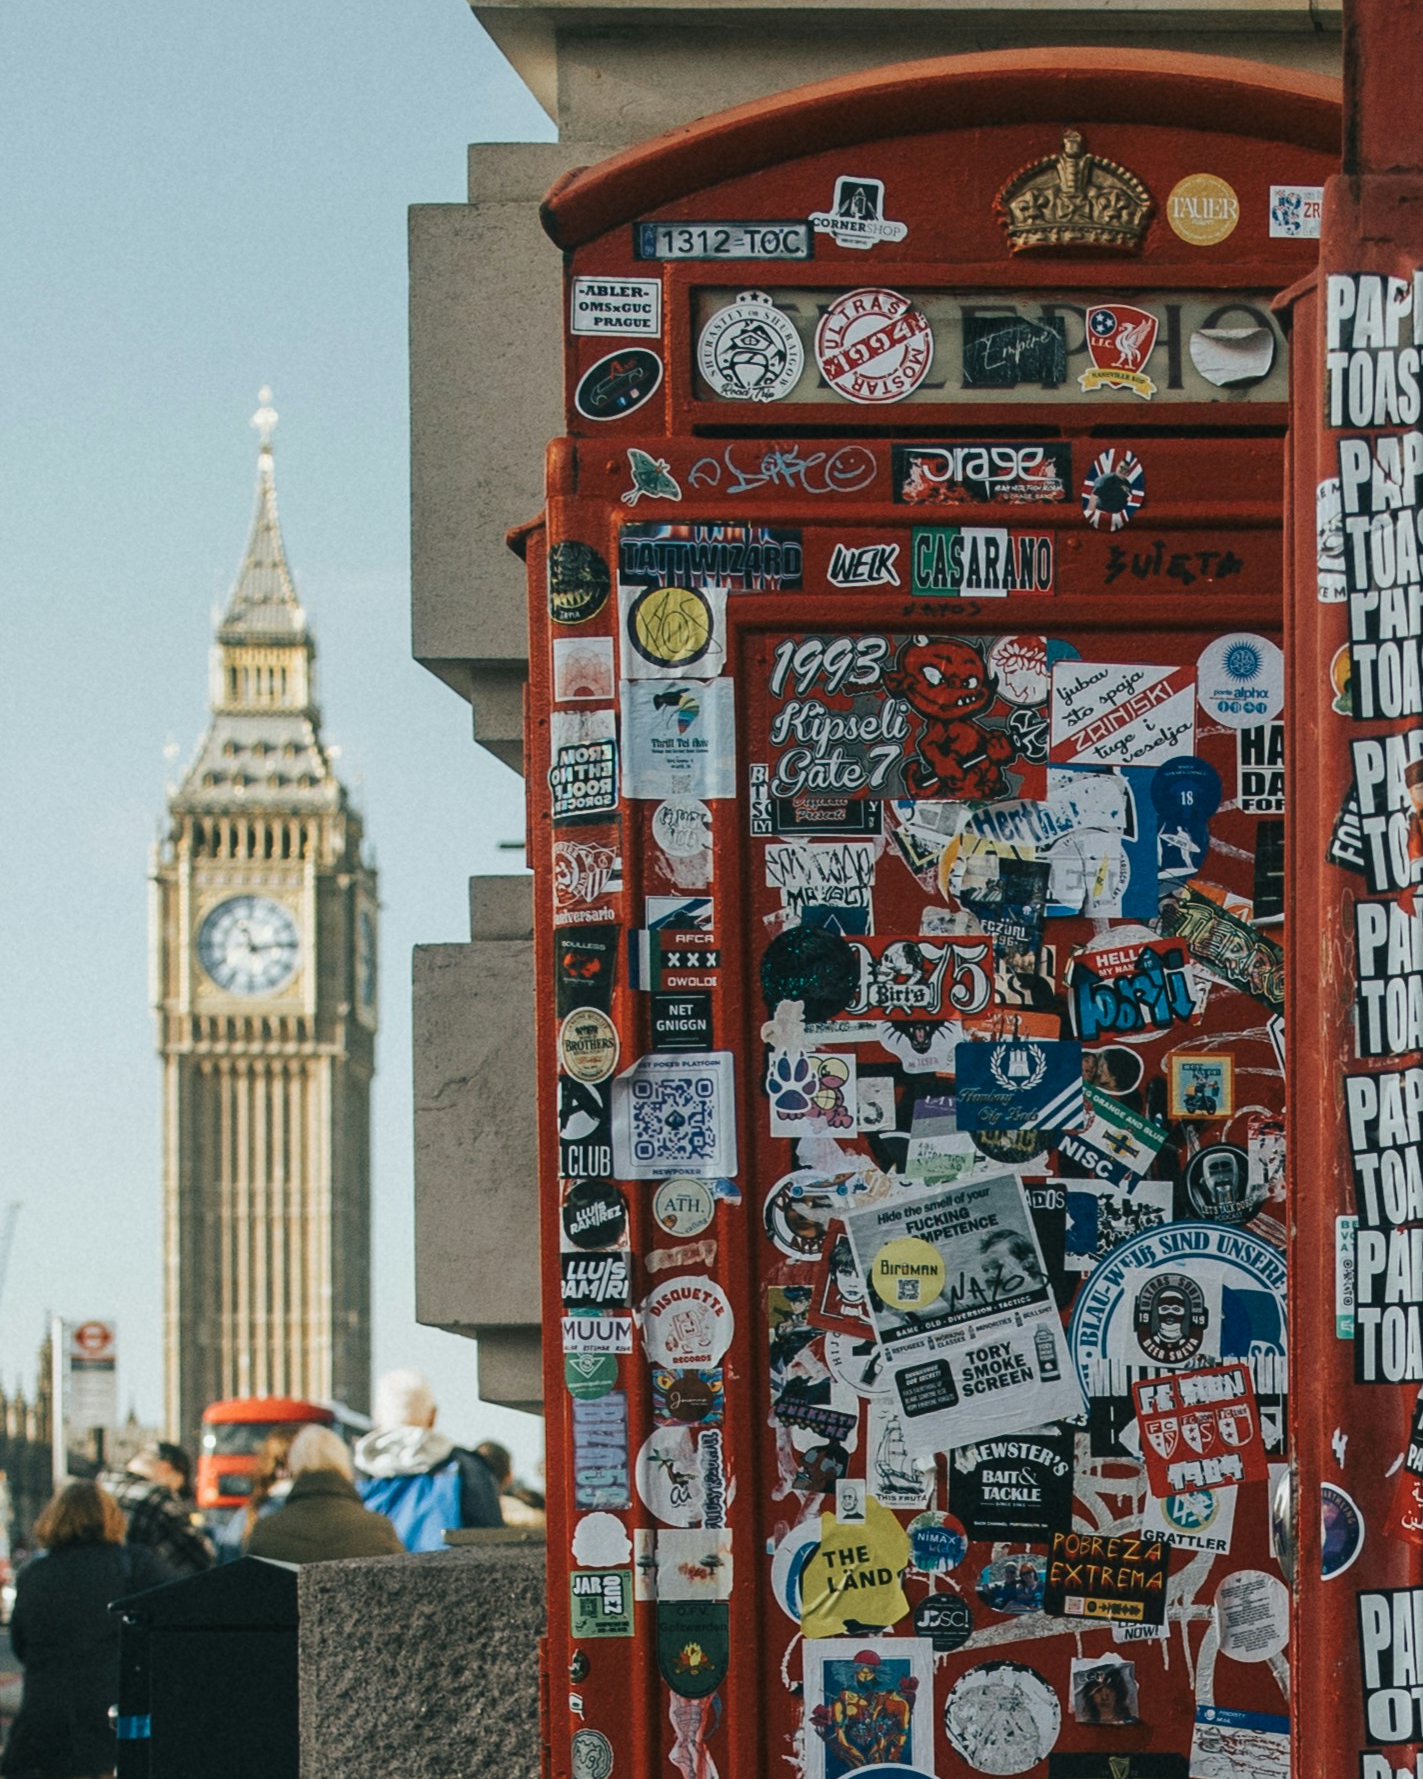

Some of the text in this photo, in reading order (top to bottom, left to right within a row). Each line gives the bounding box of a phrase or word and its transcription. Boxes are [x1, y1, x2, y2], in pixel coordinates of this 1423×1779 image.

[579, 301, 652, 314] OMSxGUC
[593, 316, 651, 328] PRAGUE
[825, 298, 900, 350] ULTRAS
[831, 545, 899, 582] WELK
[914, 534, 1053, 591] CASARANO
[772, 638, 889, 696] 1993
[1057, 669, 1108, 706] ljubav
[1062, 670, 1144, 727] što spaja
[771, 700, 910, 755] Kipseli
[1093, 718, 1156, 759] tuge i
[1122, 721, 1193, 763] veselja
[771, 745, 902, 797] Gate 7
[1181, 791, 1194, 806] 18
[676, 935, 714, 943] AFCA
[669, 1005, 693, 1015] NET
[656, 1020, 706, 1031] GNIGGN
[566, 1040, 615, 1051] BROTHERS
[1058, 1136, 1113, 1178] NISC
[877, 1187, 990, 1226] Hide the smell of your
[906, 1207, 970, 1234] FUCKING
[650, 1287, 725, 1317] DISQUETTE
[1140, 1276, 1203, 1310] ULTRAS SOUTH
[896, 1296, 1031, 1338] SAME OLD DIVERSION TACTICS
[892, 1341, 925, 1355] REFUGEES
[935, 1330, 965, 1342] WORKING
[937, 1337, 966, 1349] CLASSES
[1142, 1337, 1199, 1360] BEER SHEVA
[673, 1354, 712, 1364] RECORDS
[965, 1341, 1012, 1365] TORY
[962, 1353, 1027, 1382] SMOKE
[962, 1368, 1034, 1398] SCREEN
[982, 1467, 1038, 1485] BAIT &
[981, 1486, 1042, 1502] TACKLE
[1053, 1532, 1162, 1561] POBREZA
[1143, 1530, 1227, 1552] GRATTLER
[822, 1545, 869, 1567] THE
[573, 1576, 601, 1594] JAR
[827, 1567, 894, 1594] LÄND
[1050, 1561, 1163, 1589] EXTREMA
[603, 1575, 622, 1614] QUEZ
[1125, 1626, 1159, 1640] NOW!
